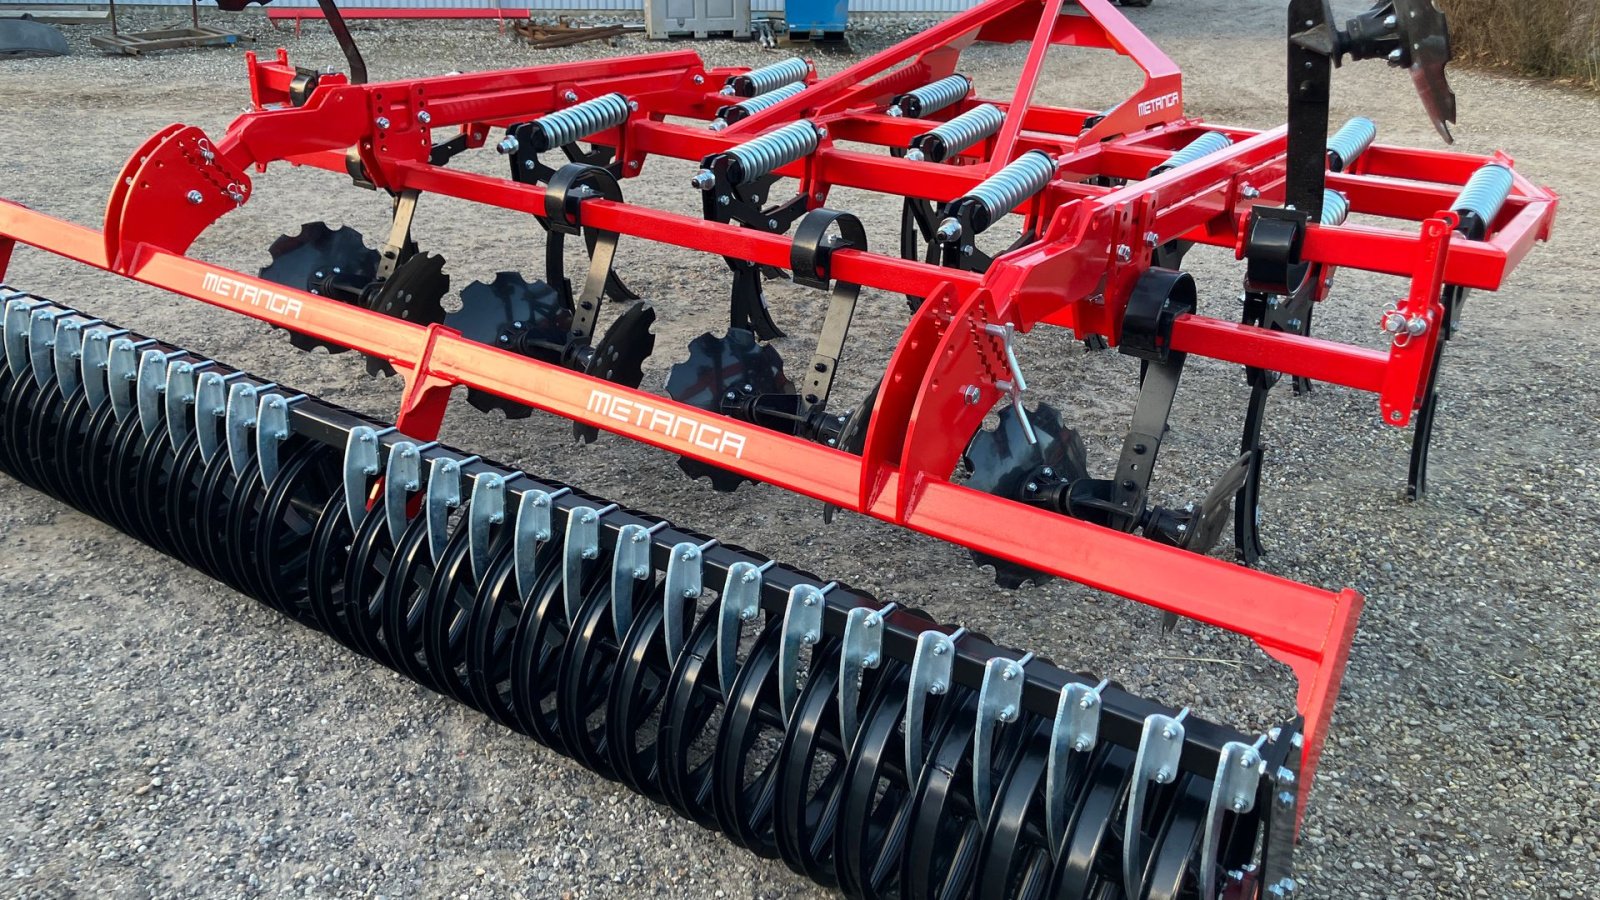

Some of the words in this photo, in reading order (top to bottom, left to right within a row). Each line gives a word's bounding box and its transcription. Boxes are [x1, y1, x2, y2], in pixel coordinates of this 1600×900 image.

[1138, 92, 1179, 116] METANGA
[203, 273, 303, 319] METANGA
[588, 390, 747, 459] METANGA
